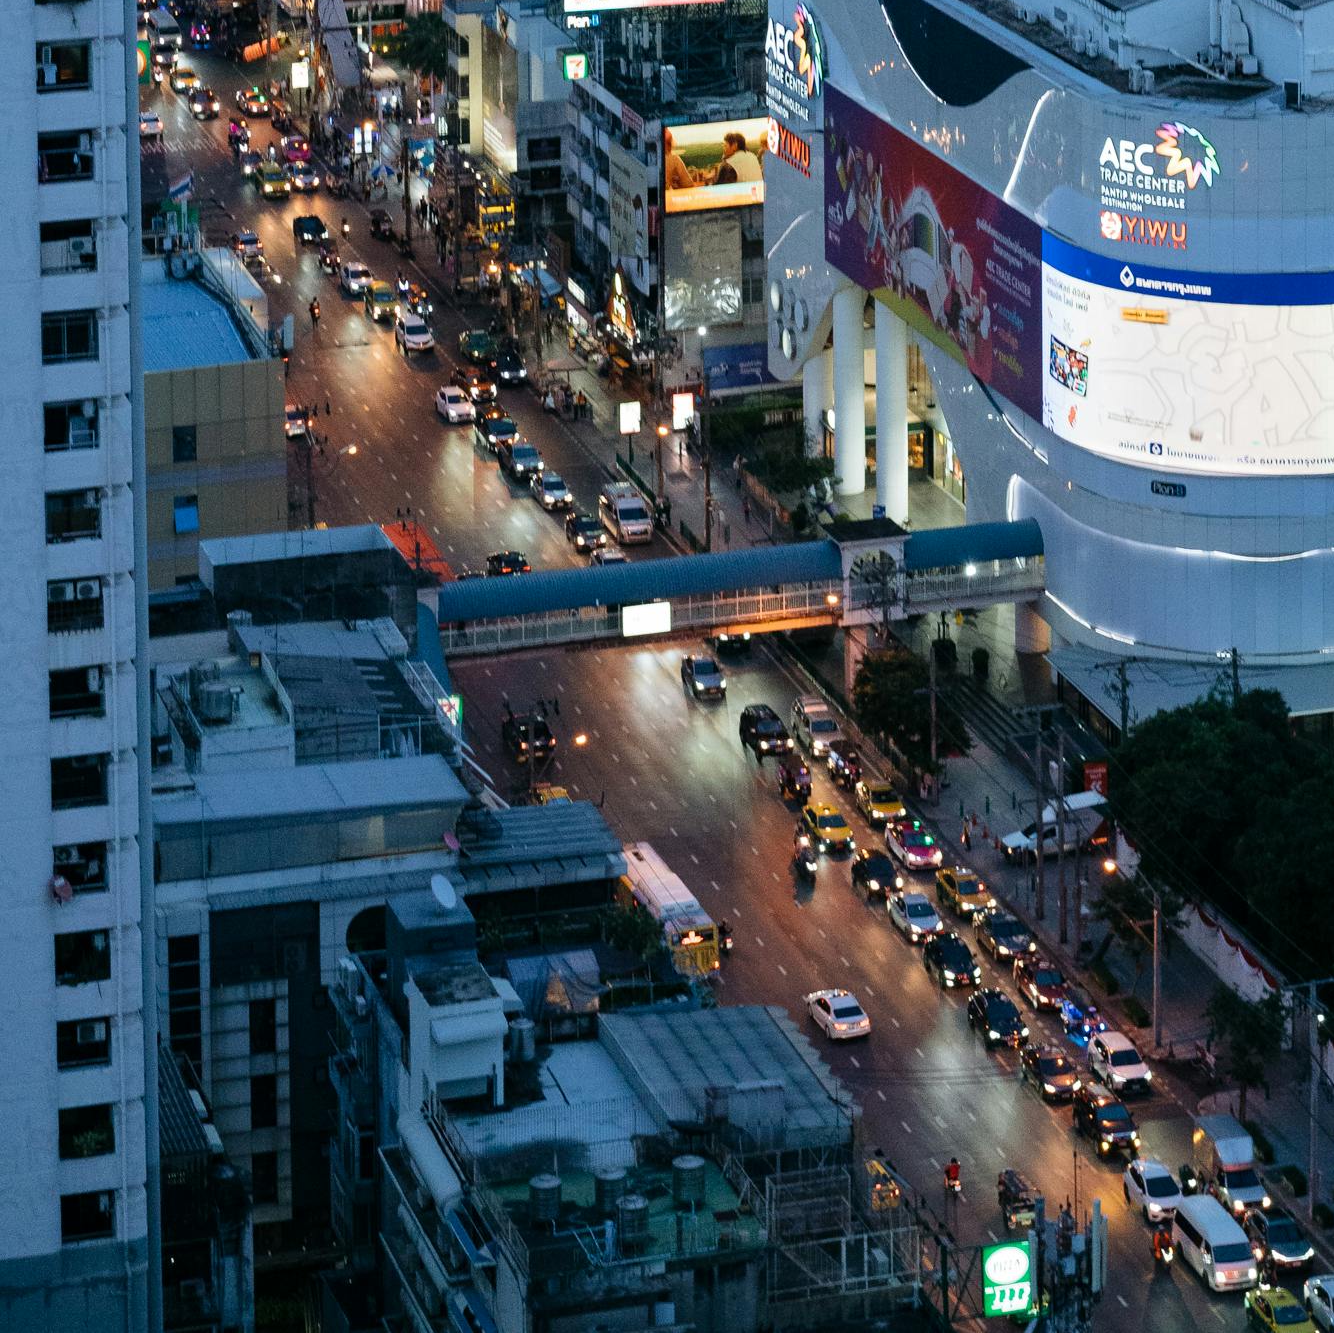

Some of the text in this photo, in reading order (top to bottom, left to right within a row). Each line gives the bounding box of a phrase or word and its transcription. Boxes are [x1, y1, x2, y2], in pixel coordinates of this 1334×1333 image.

[765, 17, 794, 71] AEC
[765, 56, 809, 101] TRADE CENTER
[779, 124, 811, 168] YIWU
[1100, 137, 1154, 175] AEC
[1100, 167, 1185, 194] TRADE CENTER
[1101, 185, 1185, 210] PANTIP WHOLESALE
[1101, 196, 1142, 212] DESTINATION
[1125, 215, 1187, 242] YIWU
